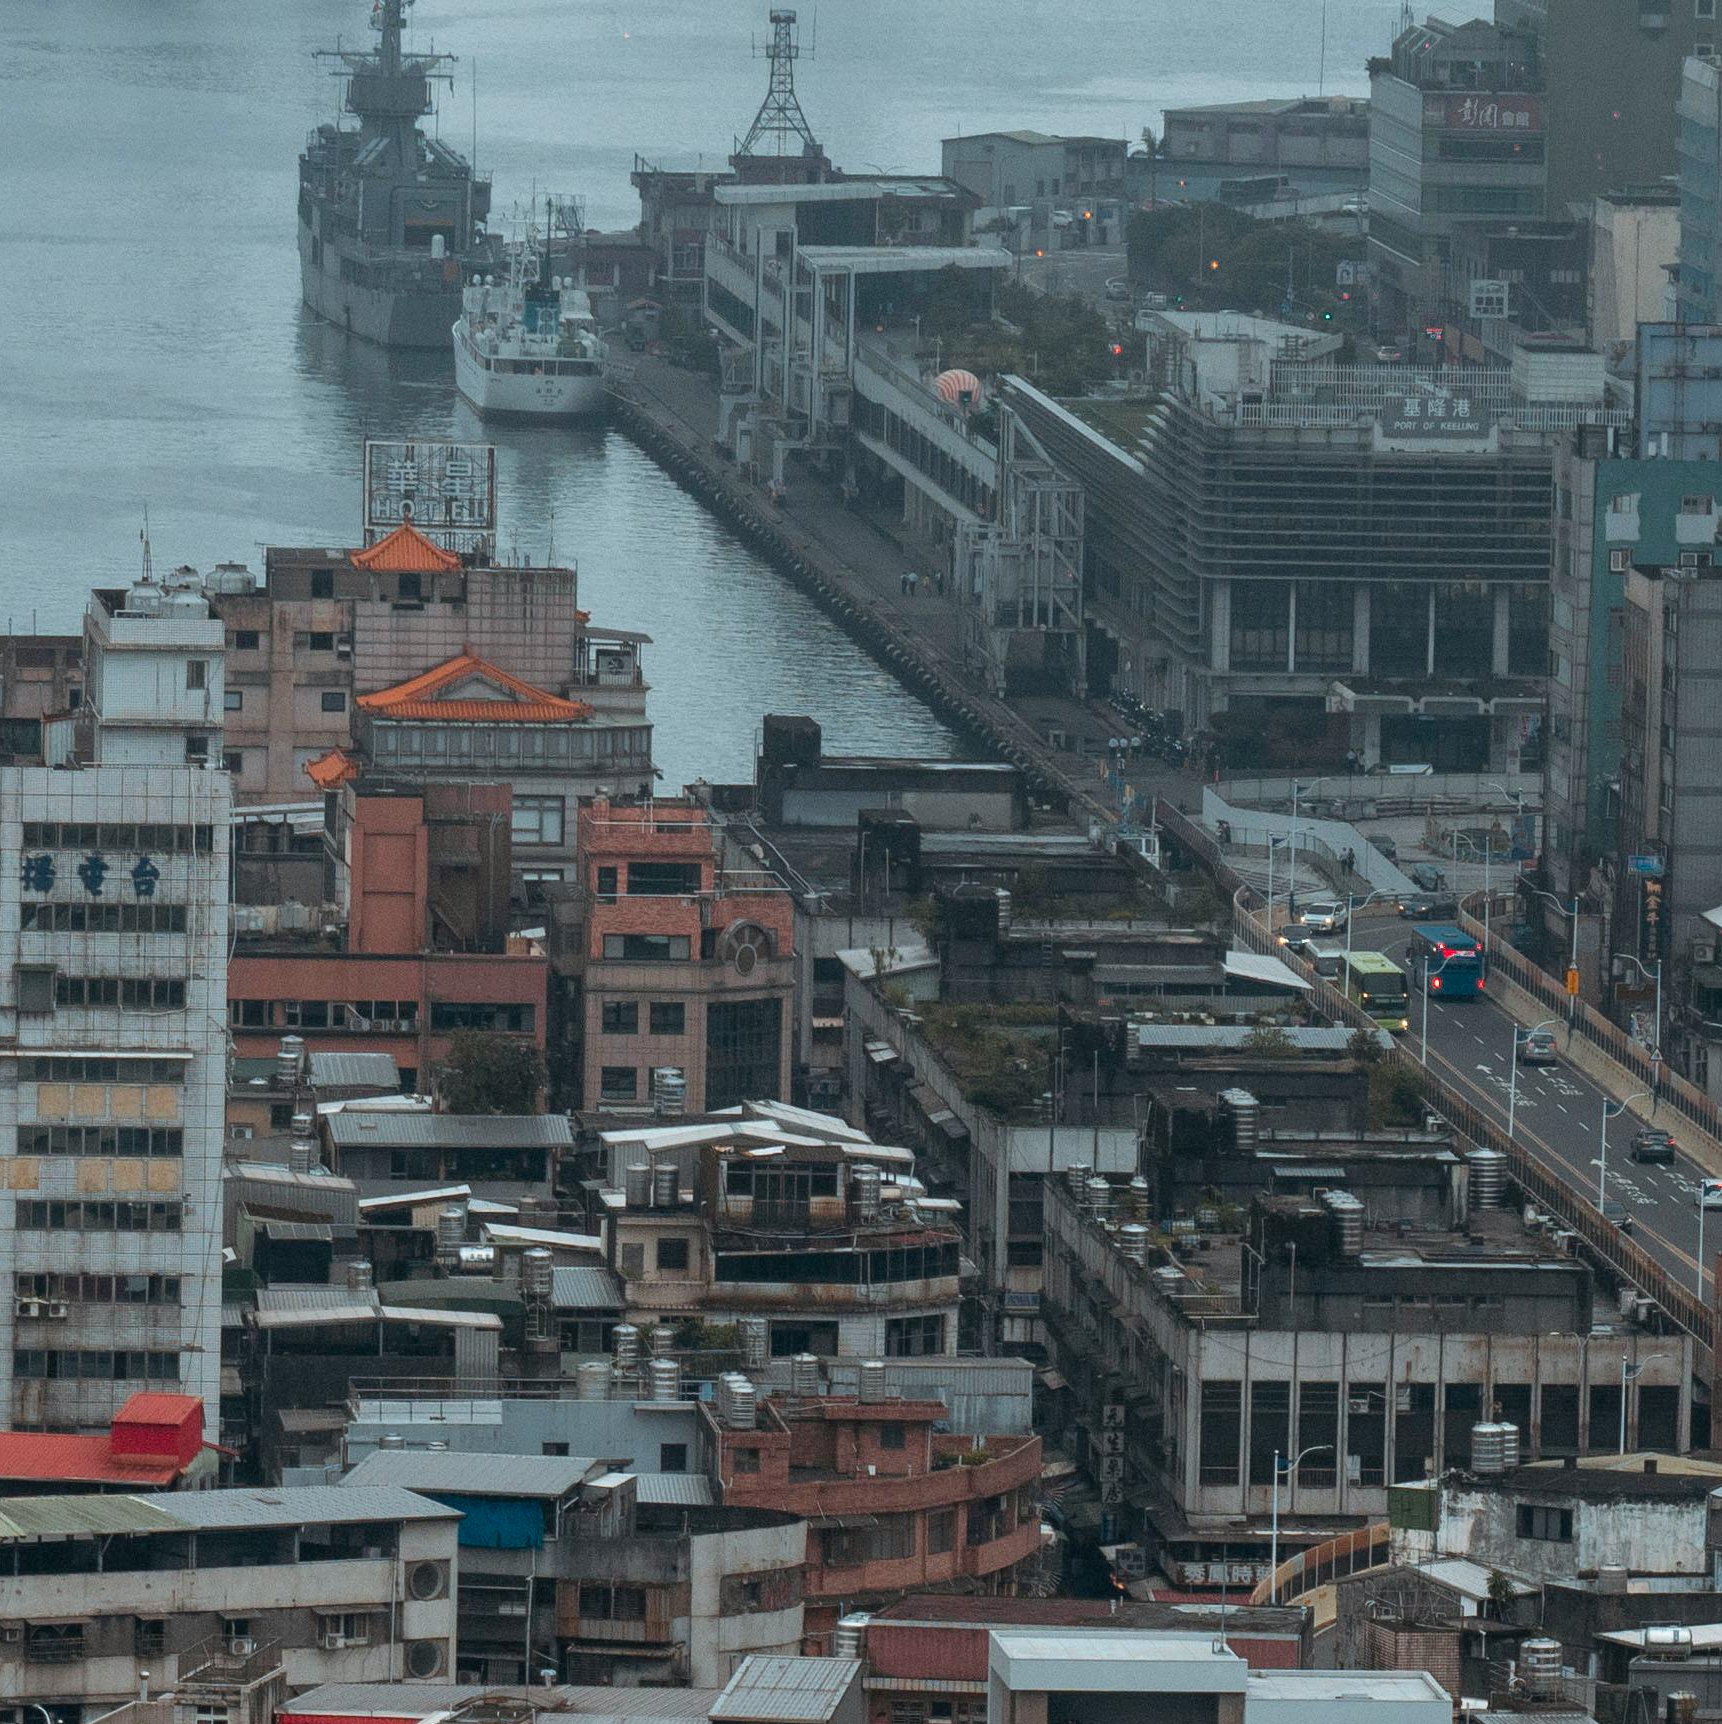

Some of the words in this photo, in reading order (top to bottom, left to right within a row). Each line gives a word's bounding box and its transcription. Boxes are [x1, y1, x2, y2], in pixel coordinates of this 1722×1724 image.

[1458, 98, 1530, 128] 彭園會館
[1403, 398, 1471, 418] 基隆港
[1394, 421, 1417, 431] PORT
[1423, 421, 1435, 431] OF
[1440, 421, 1480, 431] KEELUNG
[374, 499, 485, 520] HOTEL
